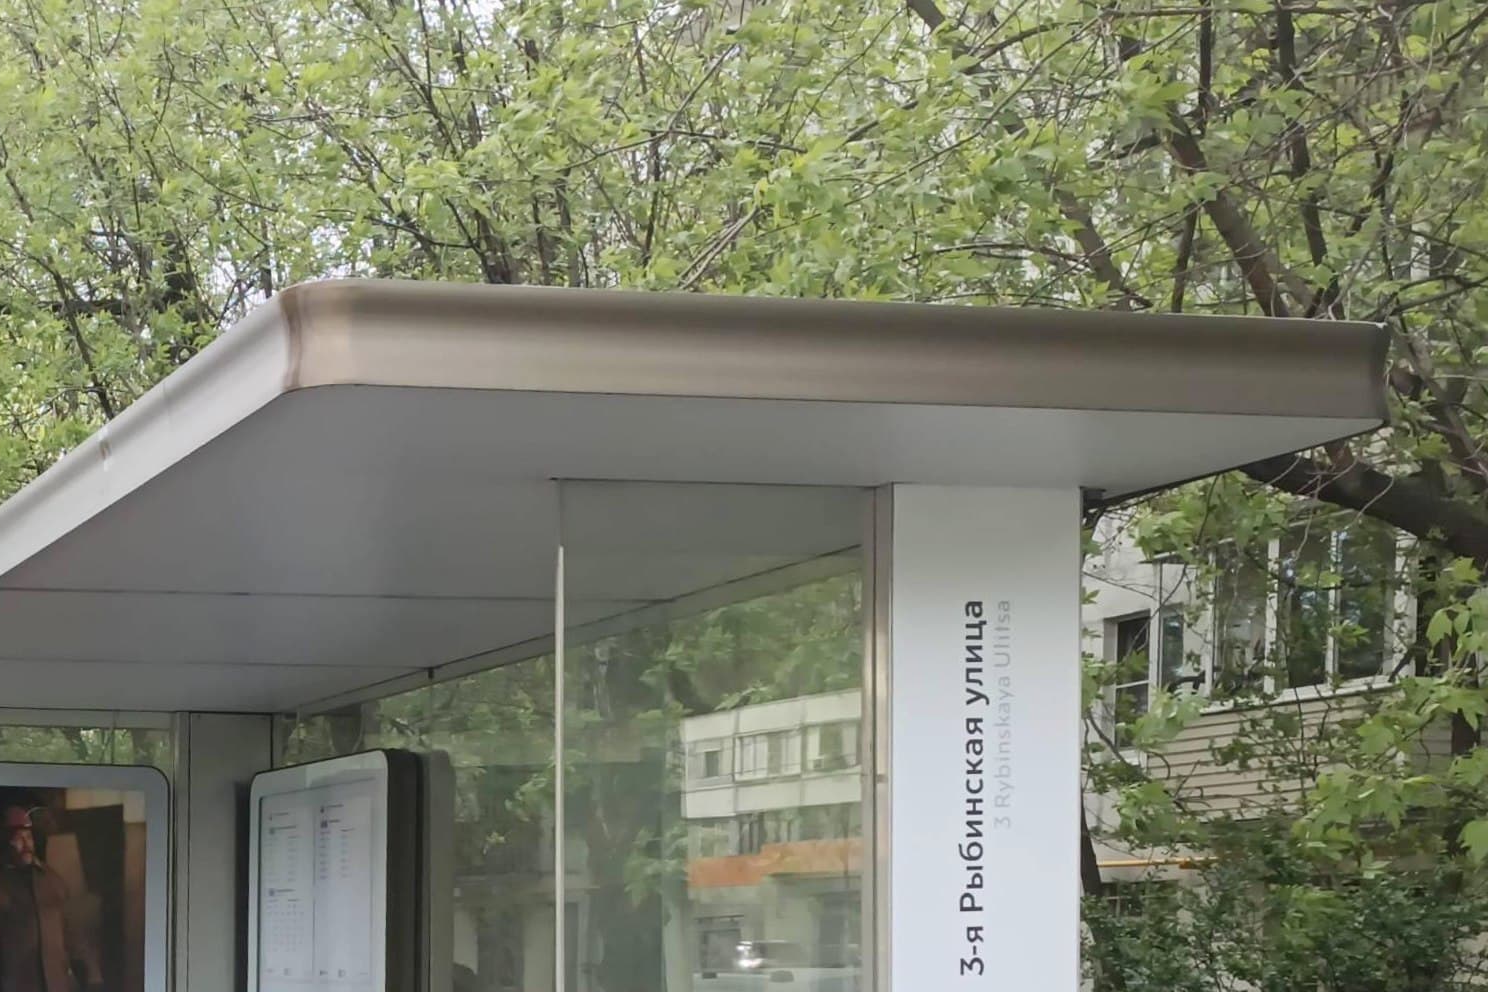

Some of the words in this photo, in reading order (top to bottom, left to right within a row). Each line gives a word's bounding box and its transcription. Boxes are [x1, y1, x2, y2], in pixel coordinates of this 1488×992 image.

[965, 600, 989, 706] улица
[993, 600, 1010, 667] Ulitsa
[993, 676, 1014, 807] Rybinskaya
[958, 718, 983, 912] Рыбинская
[994, 816, 1010, 830] 3
[960, 926, 984, 976] 3-я
